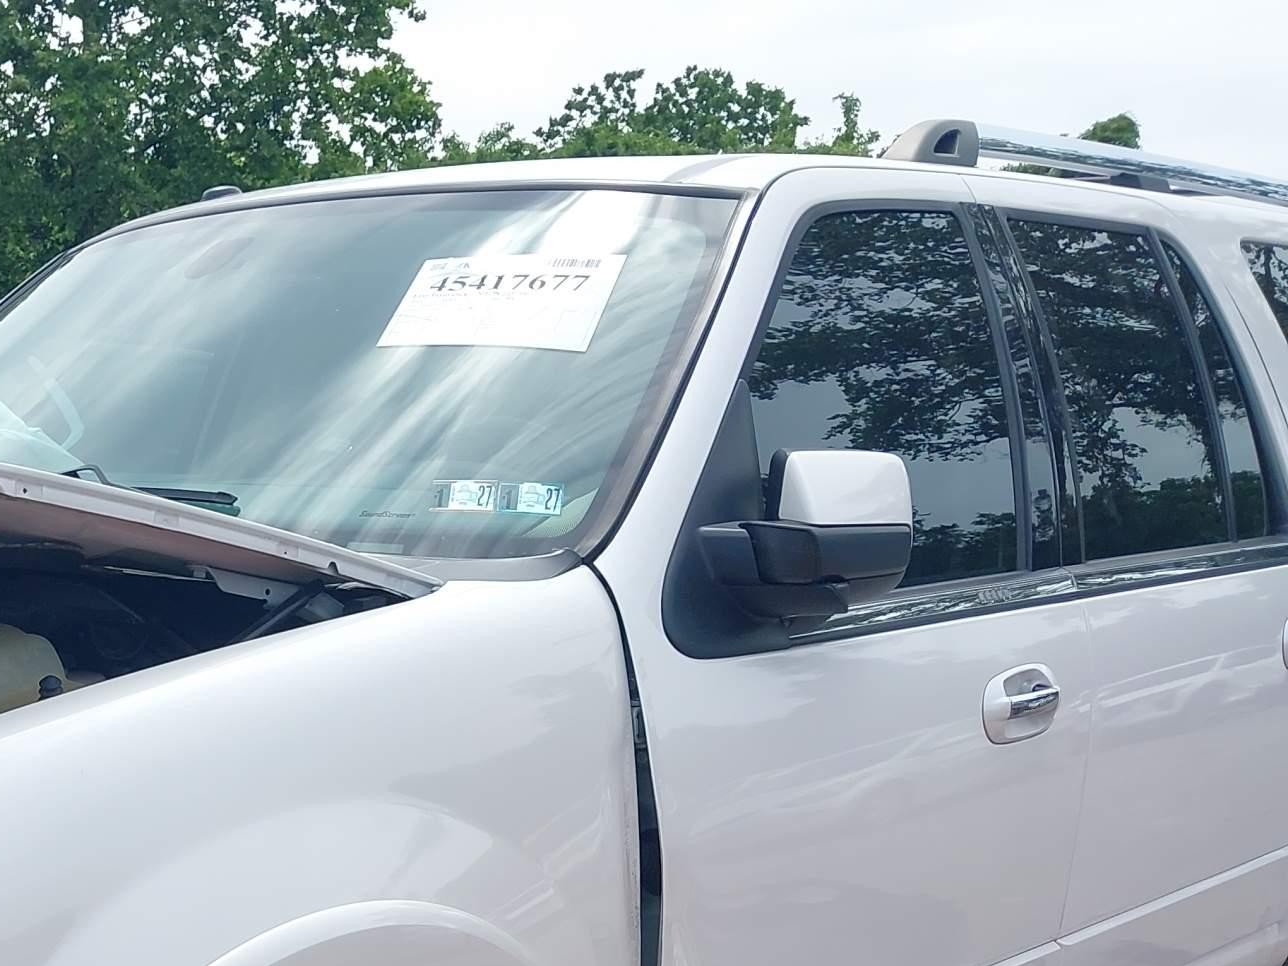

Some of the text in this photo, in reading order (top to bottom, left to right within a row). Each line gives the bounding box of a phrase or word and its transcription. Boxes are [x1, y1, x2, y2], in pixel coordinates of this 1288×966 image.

[429, 274, 591, 292] 45417677
[477, 485, 493, 508] 27
[544, 487, 561, 512] 27
